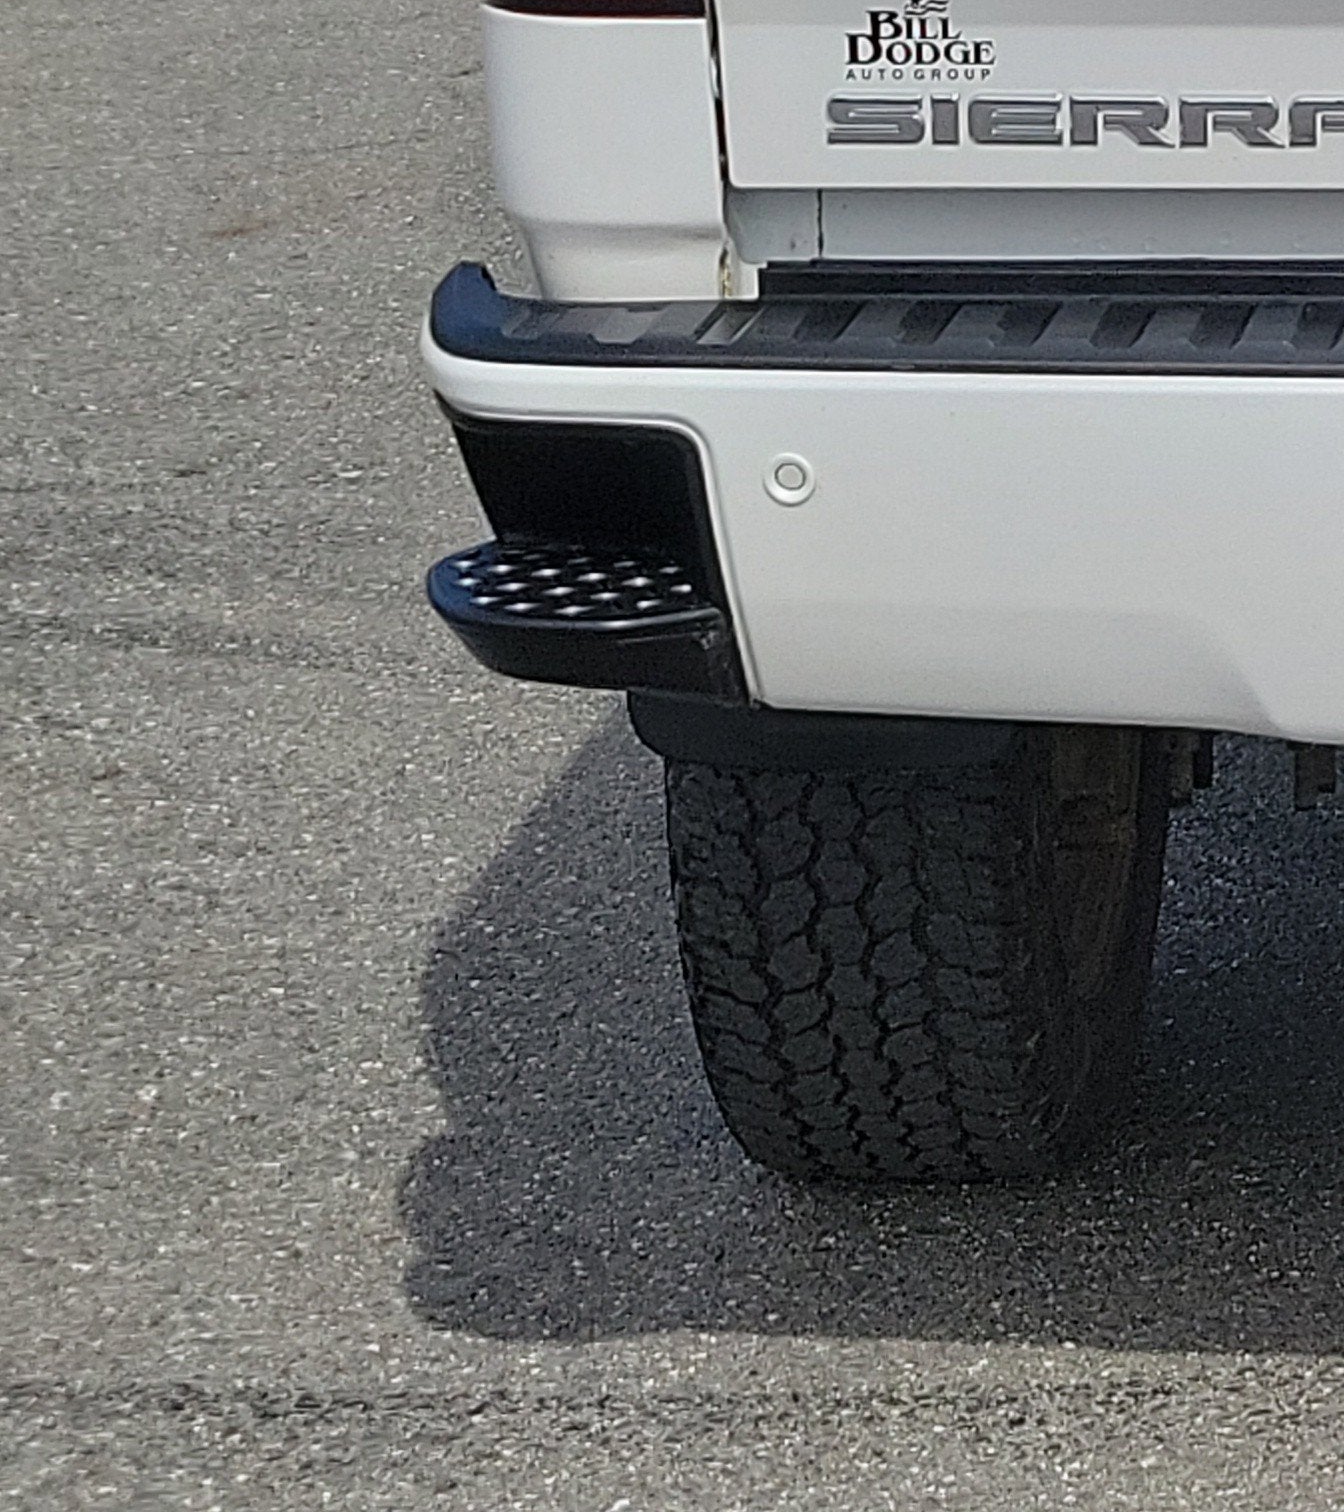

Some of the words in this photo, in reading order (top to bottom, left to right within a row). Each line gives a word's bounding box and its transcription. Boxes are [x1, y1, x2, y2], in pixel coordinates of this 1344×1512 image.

[865, 10, 962, 39] BILL
[845, 33, 995, 65] DODGE
[846, 68, 904, 81] AUTO
[913, 68, 991, 81] GROUP
